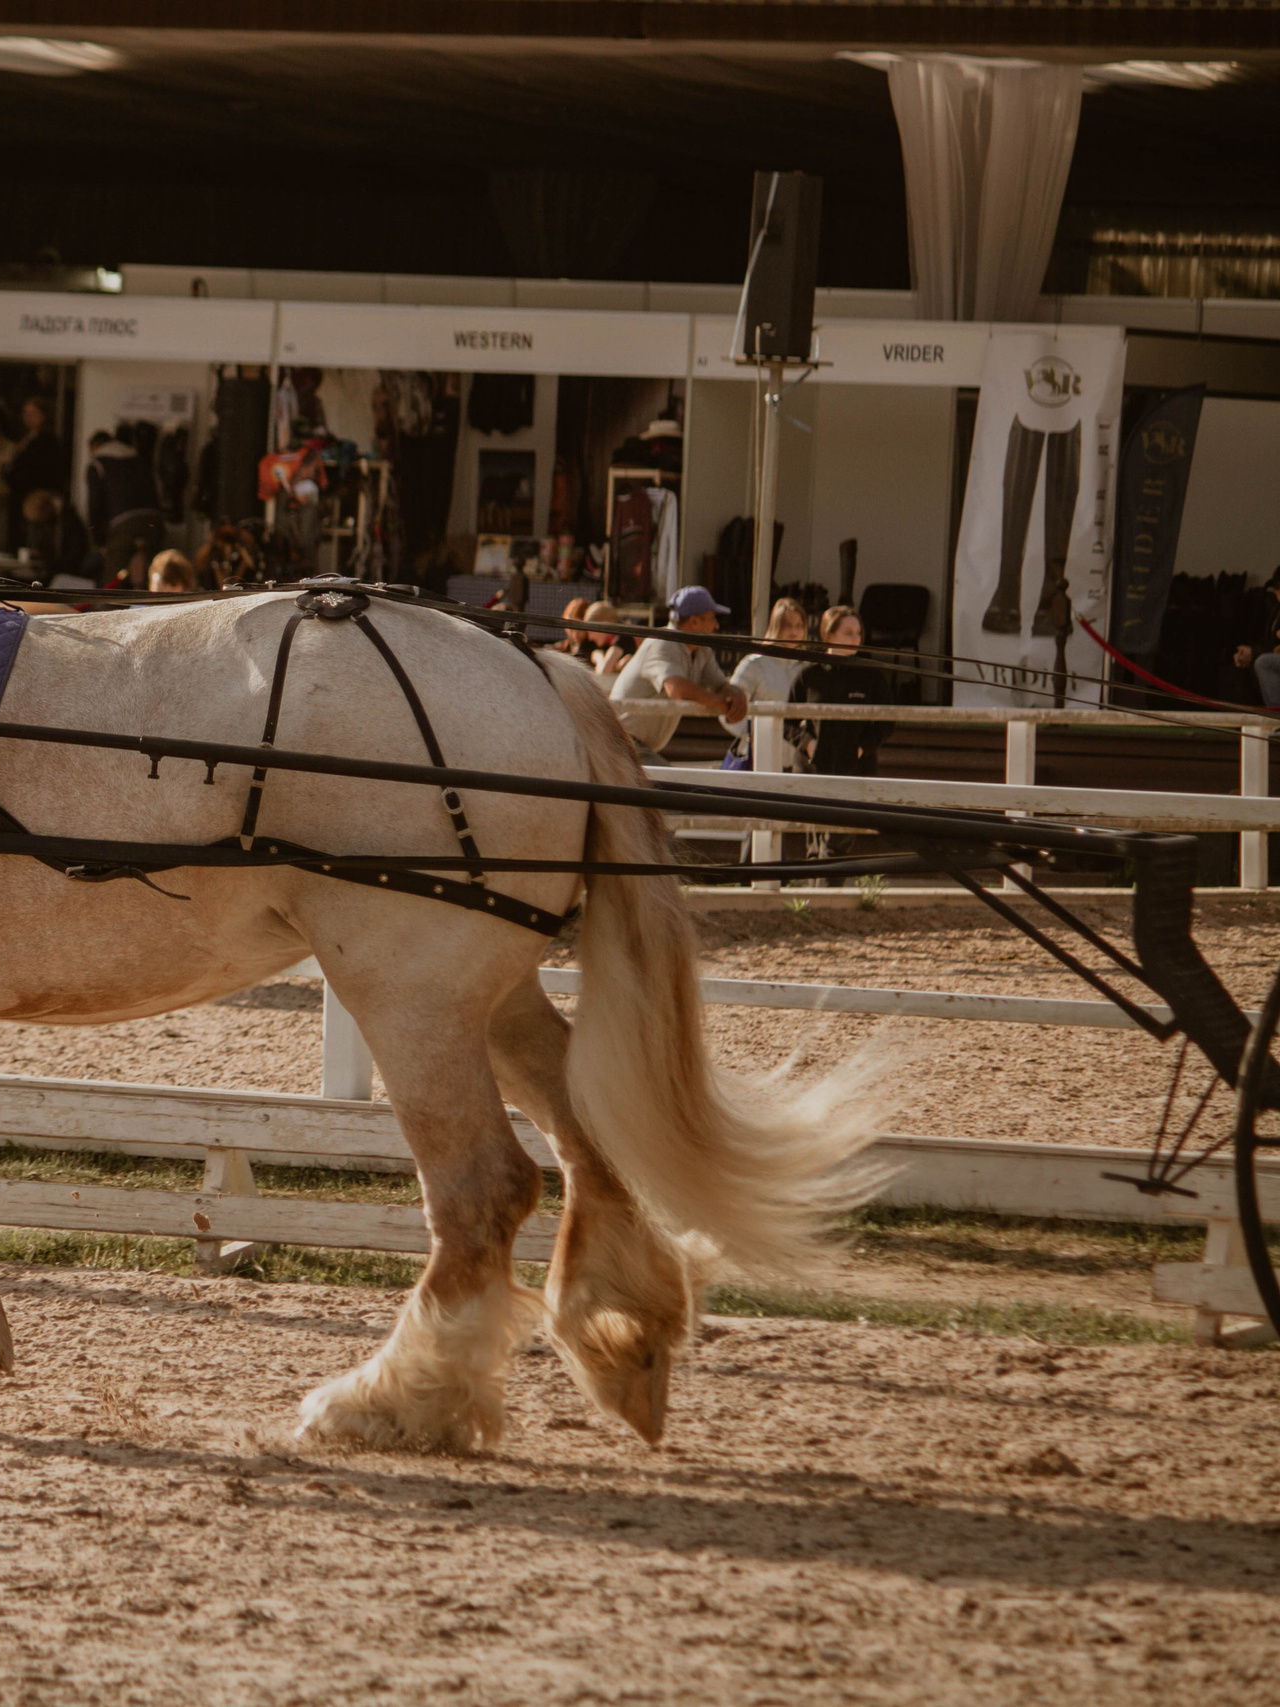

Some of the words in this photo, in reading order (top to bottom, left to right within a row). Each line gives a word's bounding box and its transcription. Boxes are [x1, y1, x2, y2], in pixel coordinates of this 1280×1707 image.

[20, 314, 85, 335] ЛАДОГА
[88, 317, 138, 338] ПЛЮС
[454, 330, 533, 350] WESTERN
[882, 343, 944, 363] VRIDER
